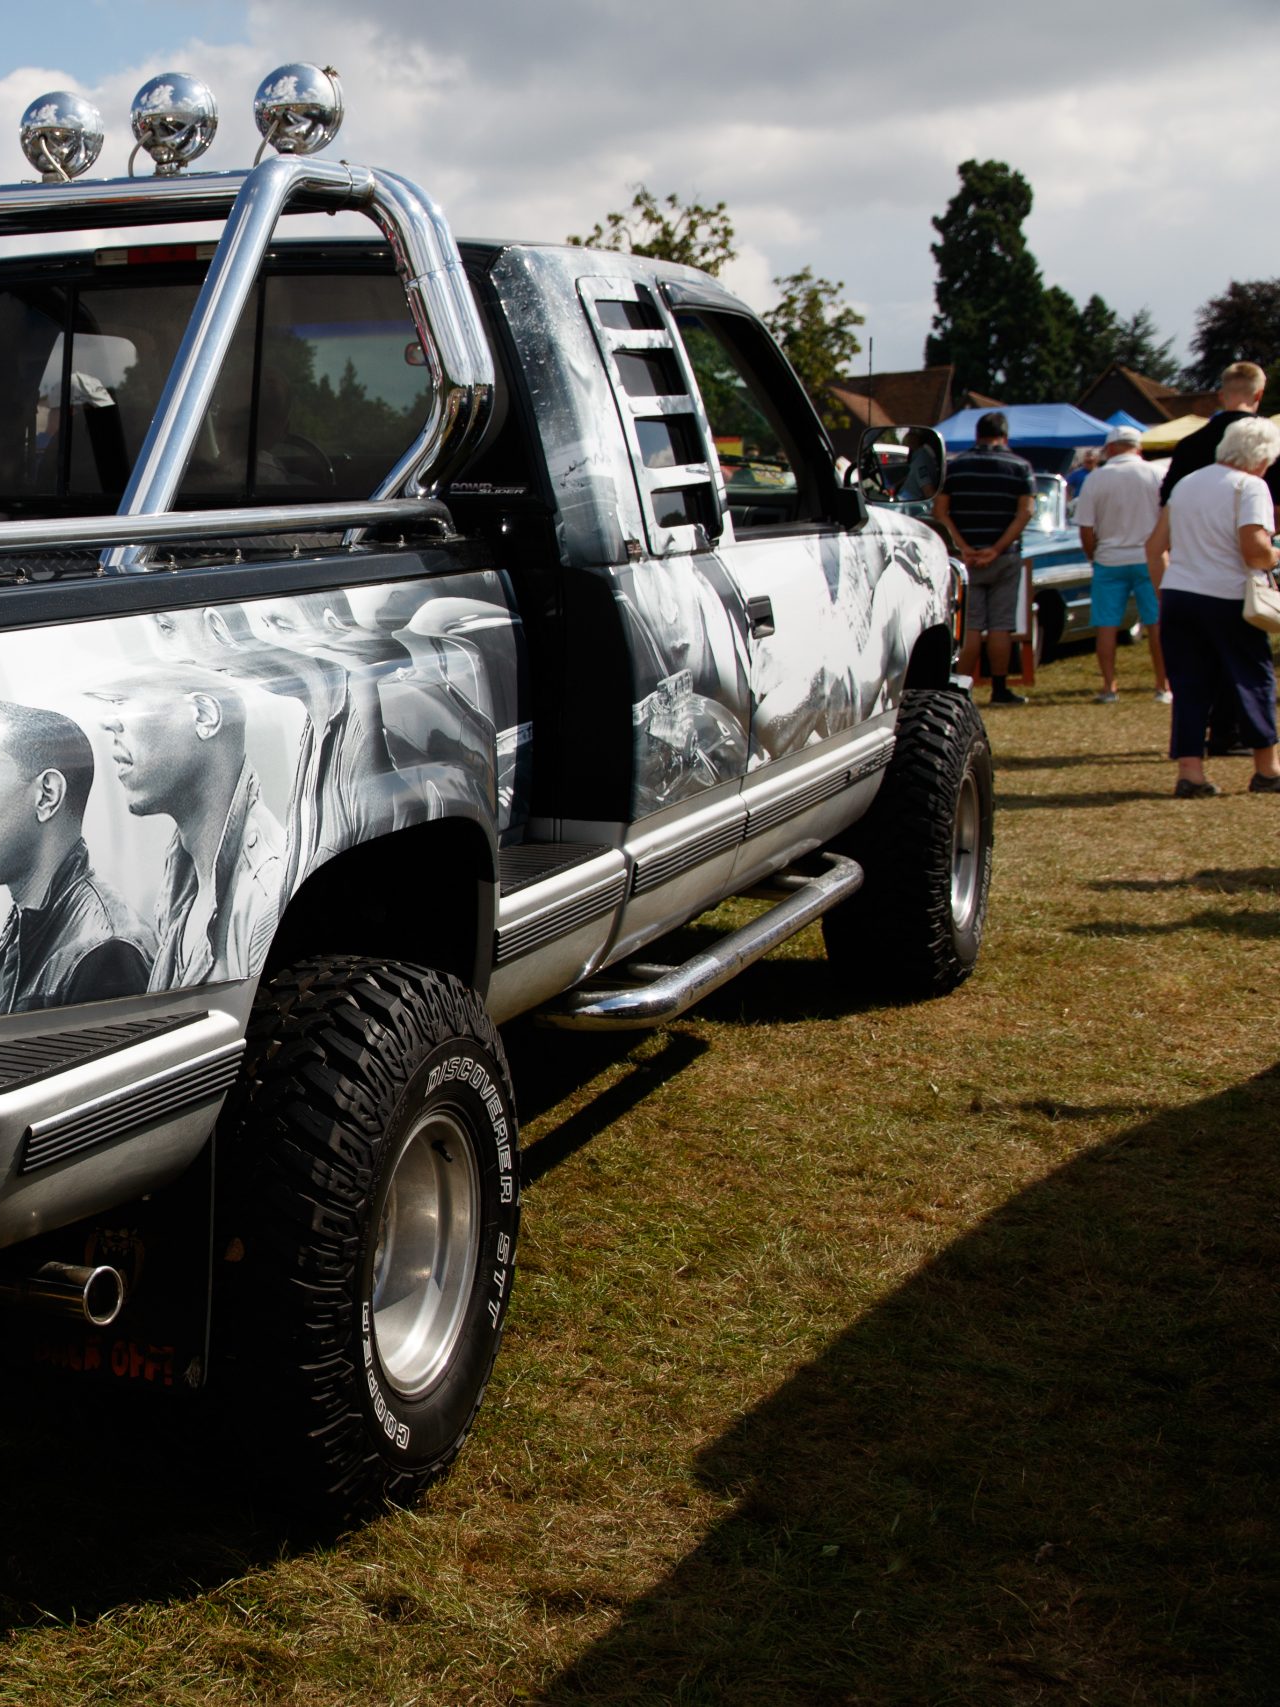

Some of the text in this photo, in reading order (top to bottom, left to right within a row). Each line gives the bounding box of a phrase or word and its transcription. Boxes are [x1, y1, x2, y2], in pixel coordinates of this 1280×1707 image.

[424, 1056, 513, 1204] DISCOVERER
[487, 1230, 511, 1330] STT
[361, 1301, 410, 1450] COOPER
